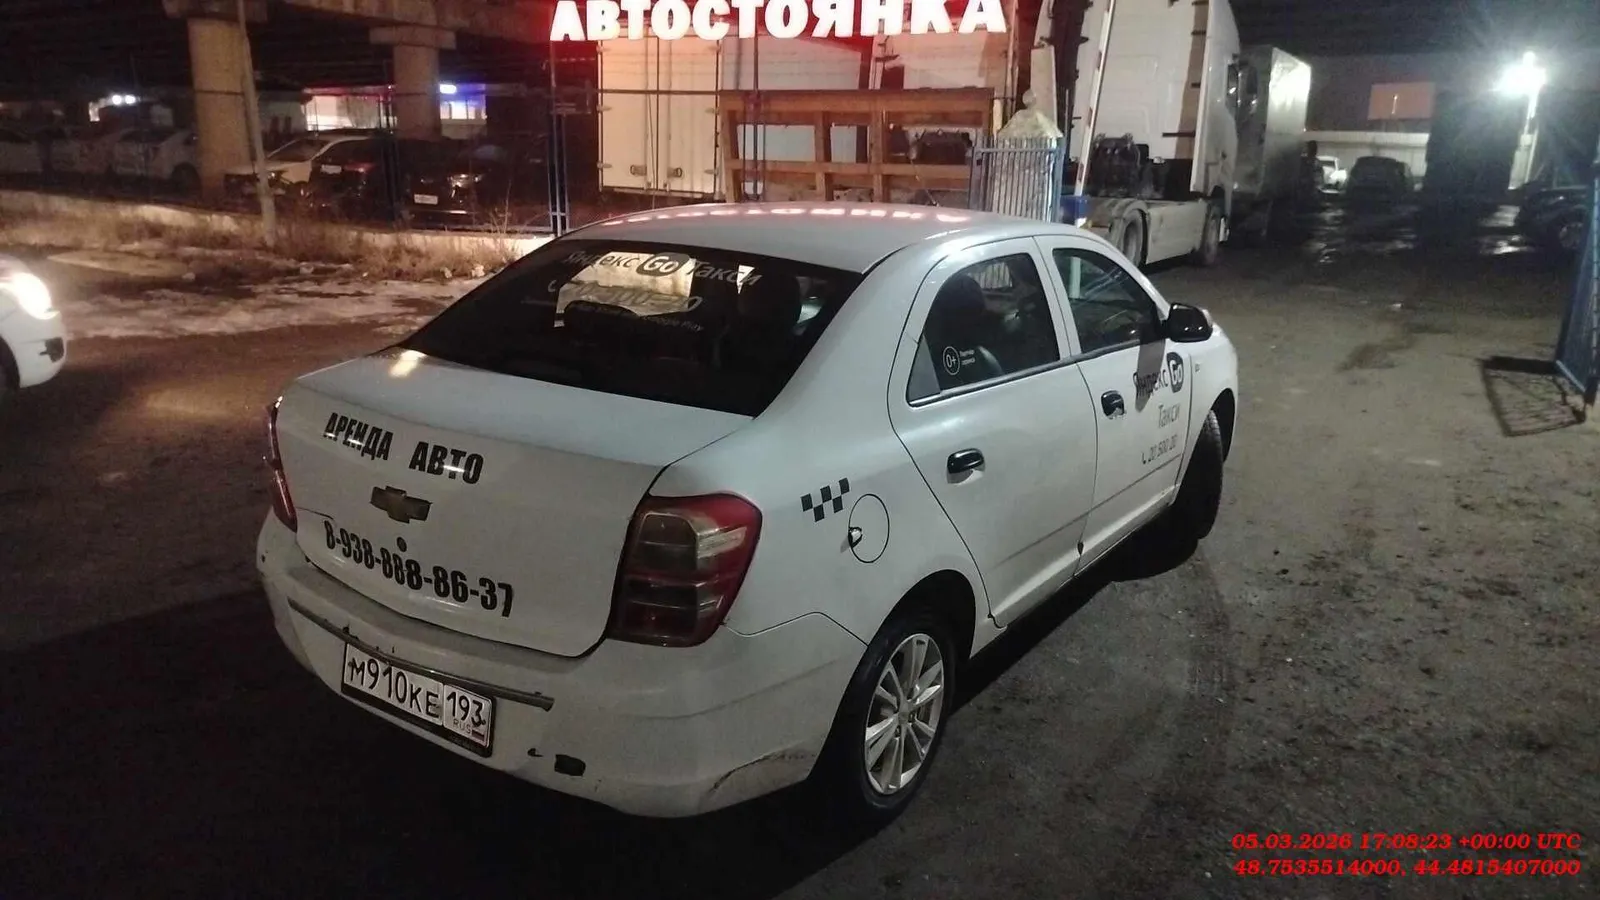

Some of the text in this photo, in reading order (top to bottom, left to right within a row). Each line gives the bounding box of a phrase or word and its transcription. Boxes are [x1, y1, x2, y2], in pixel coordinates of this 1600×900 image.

[550, 0, 1007, 41] АВТОСТОЯНКА
[642, 255, 680, 274] Go
[687, 260, 763, 286] Такси
[324, 413, 484, 484] АРЕНДА АВТО
[324, 520, 514, 618] 8-938-888-86-37
[446, 691, 484, 727] 193
[452, 718, 472, 735] RUS
